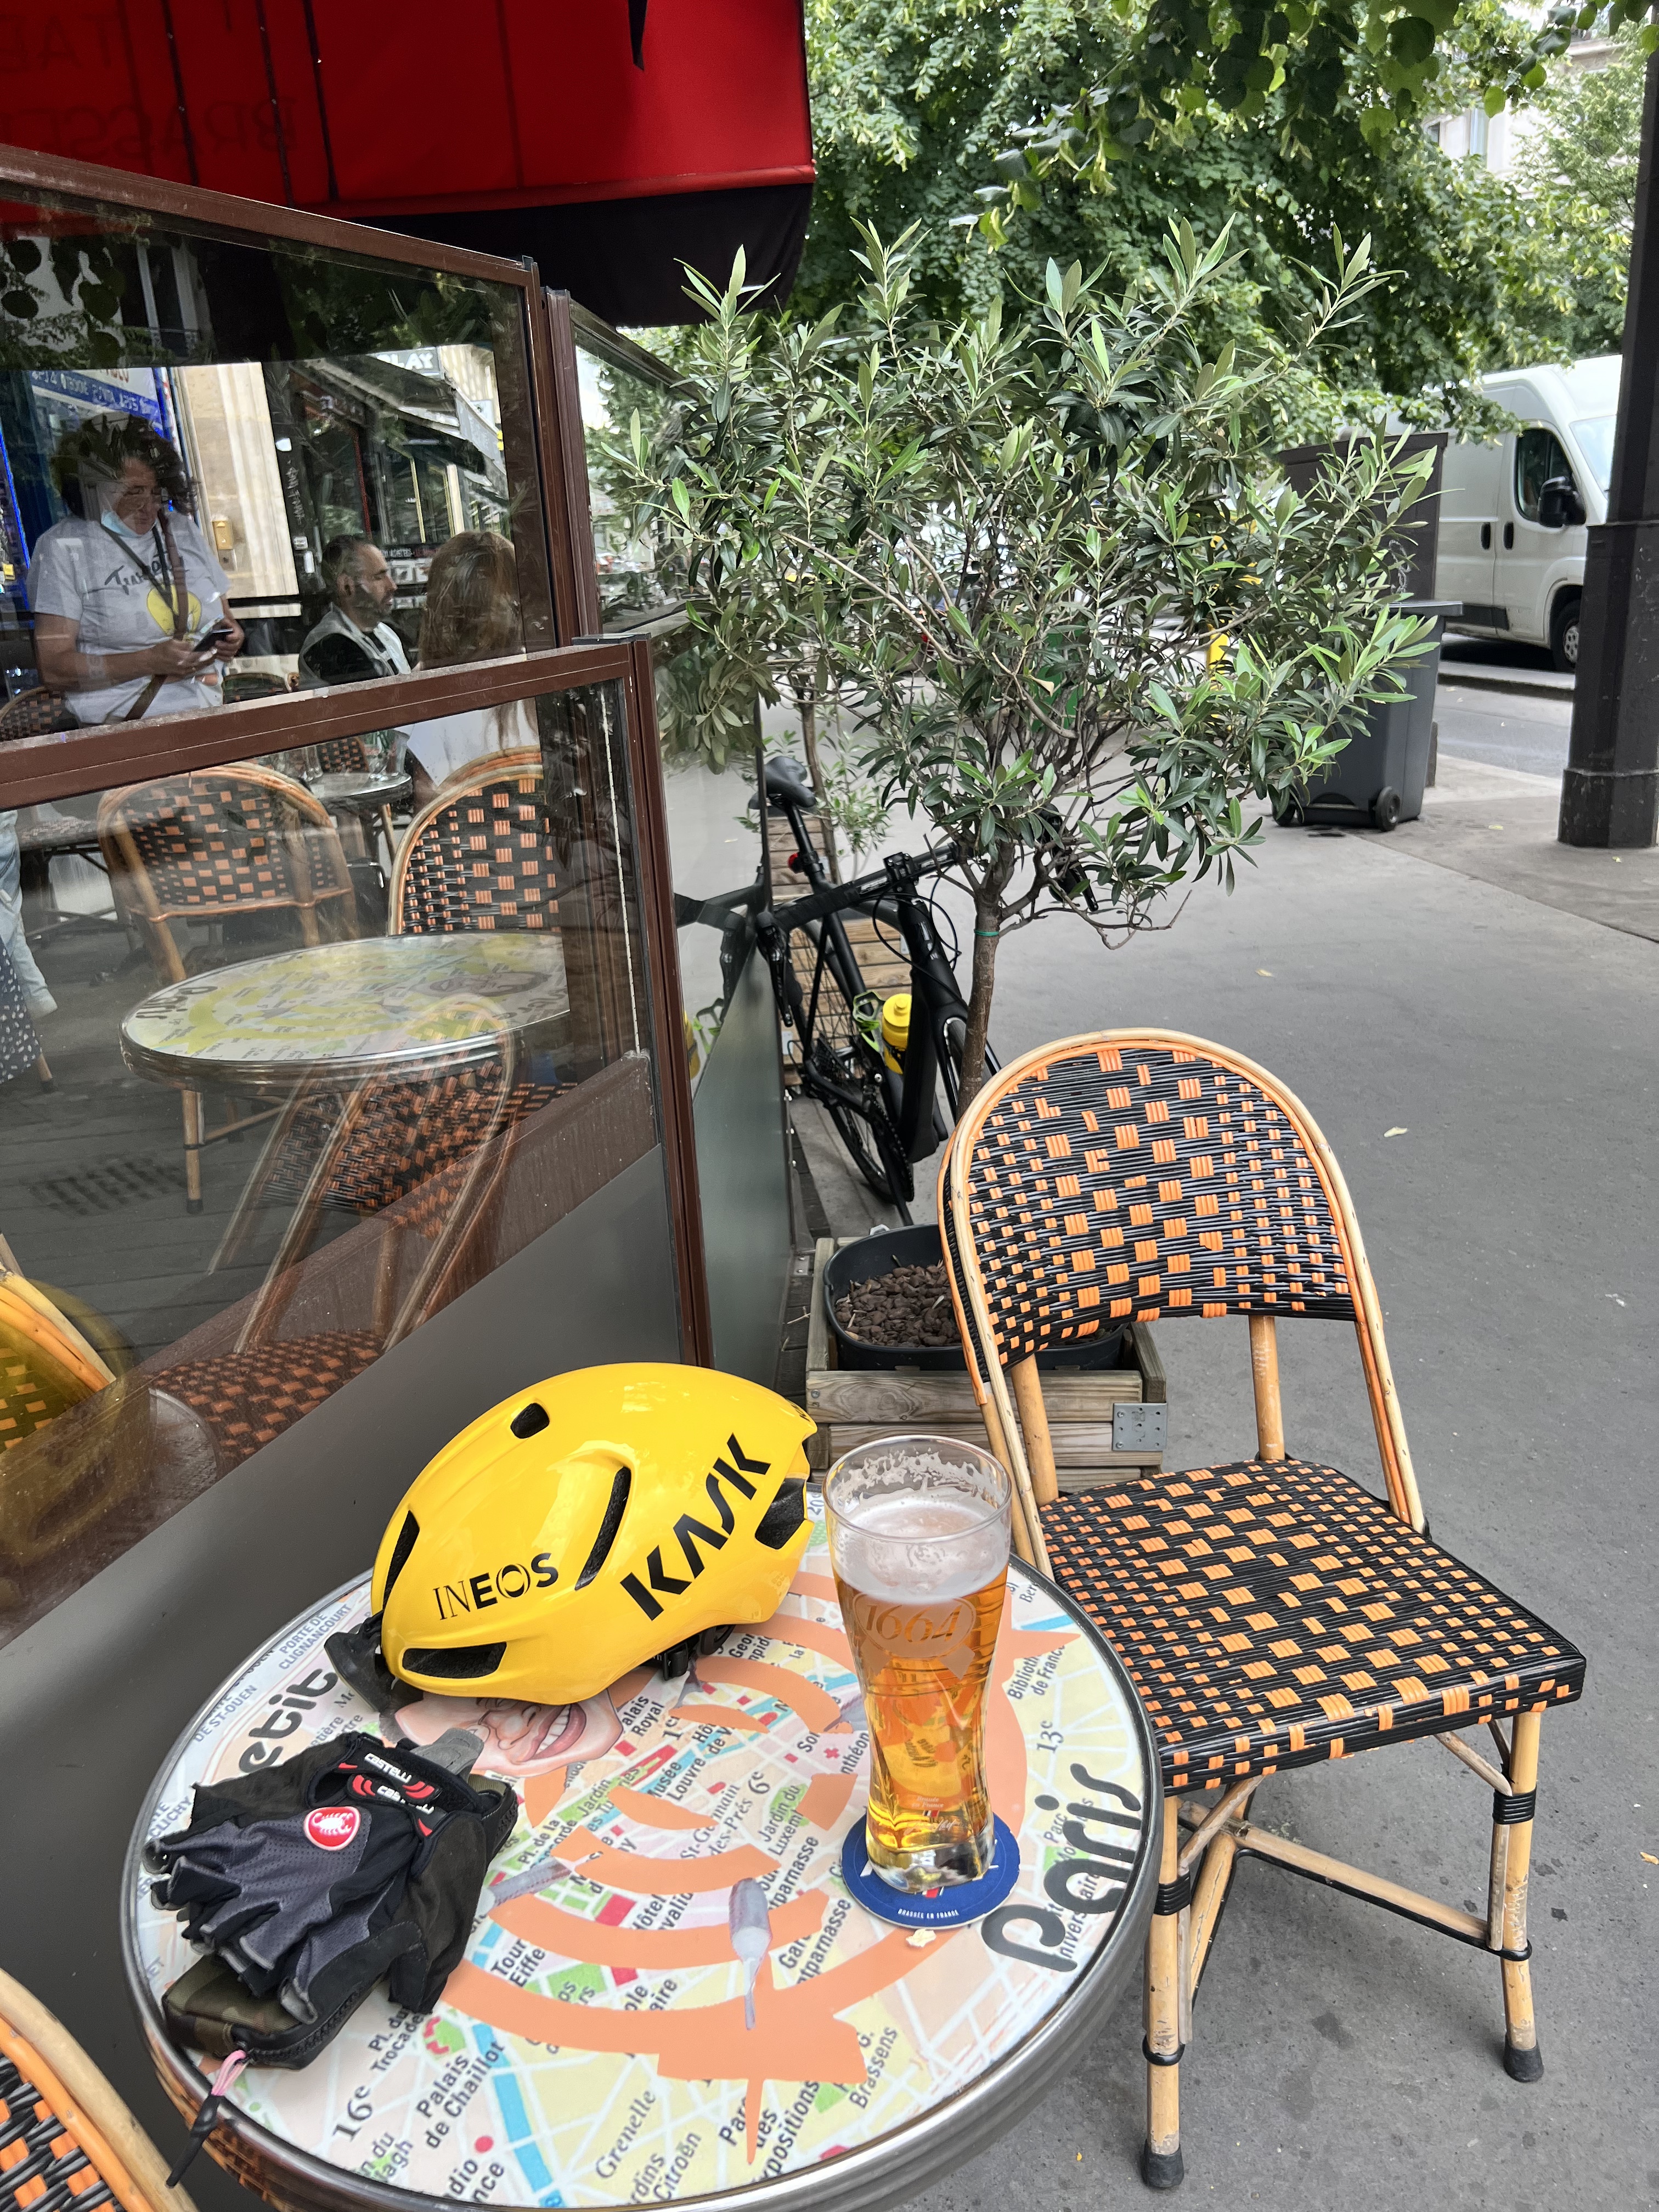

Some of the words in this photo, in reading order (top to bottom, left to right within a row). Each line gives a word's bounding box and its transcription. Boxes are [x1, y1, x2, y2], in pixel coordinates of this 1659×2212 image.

[620, 1433, 771, 1621] KASK
[432, 1552, 558, 1620] INEOS
[278, 1604, 352, 1671] CLIGNANCOURT
[279, 1624, 314, 1654] PORTE
[311, 1611, 330, 1627] DE
[865, 1604, 964, 1645] 1664
[208, 1685, 257, 1728] ST-OUEN
[1033, 1680, 1048, 1696] de
[631, 1701, 664, 1737] Royal
[708, 1738, 726, 1755] de
[582, 1779, 611, 1818] Jardin
[668, 1757, 707, 1802] Louvre
[533, 1832, 551, 1847] de
[542, 1819, 561, 1832] la
[758, 1800, 789, 1843] Jardin
[783, 1784, 801, 1802] du
[936, 1909, 960, 1919] FRANCE
[490, 1938, 527, 1976] Tour
[416, 2055, 470, 2119] Palais
[849, 2026, 898, 2110] Brassens
[423, 2121, 449, 2149] de
[443, 2040, 506, 2118] Chaillot
[595, 2090, 656, 2179] Grenelle
